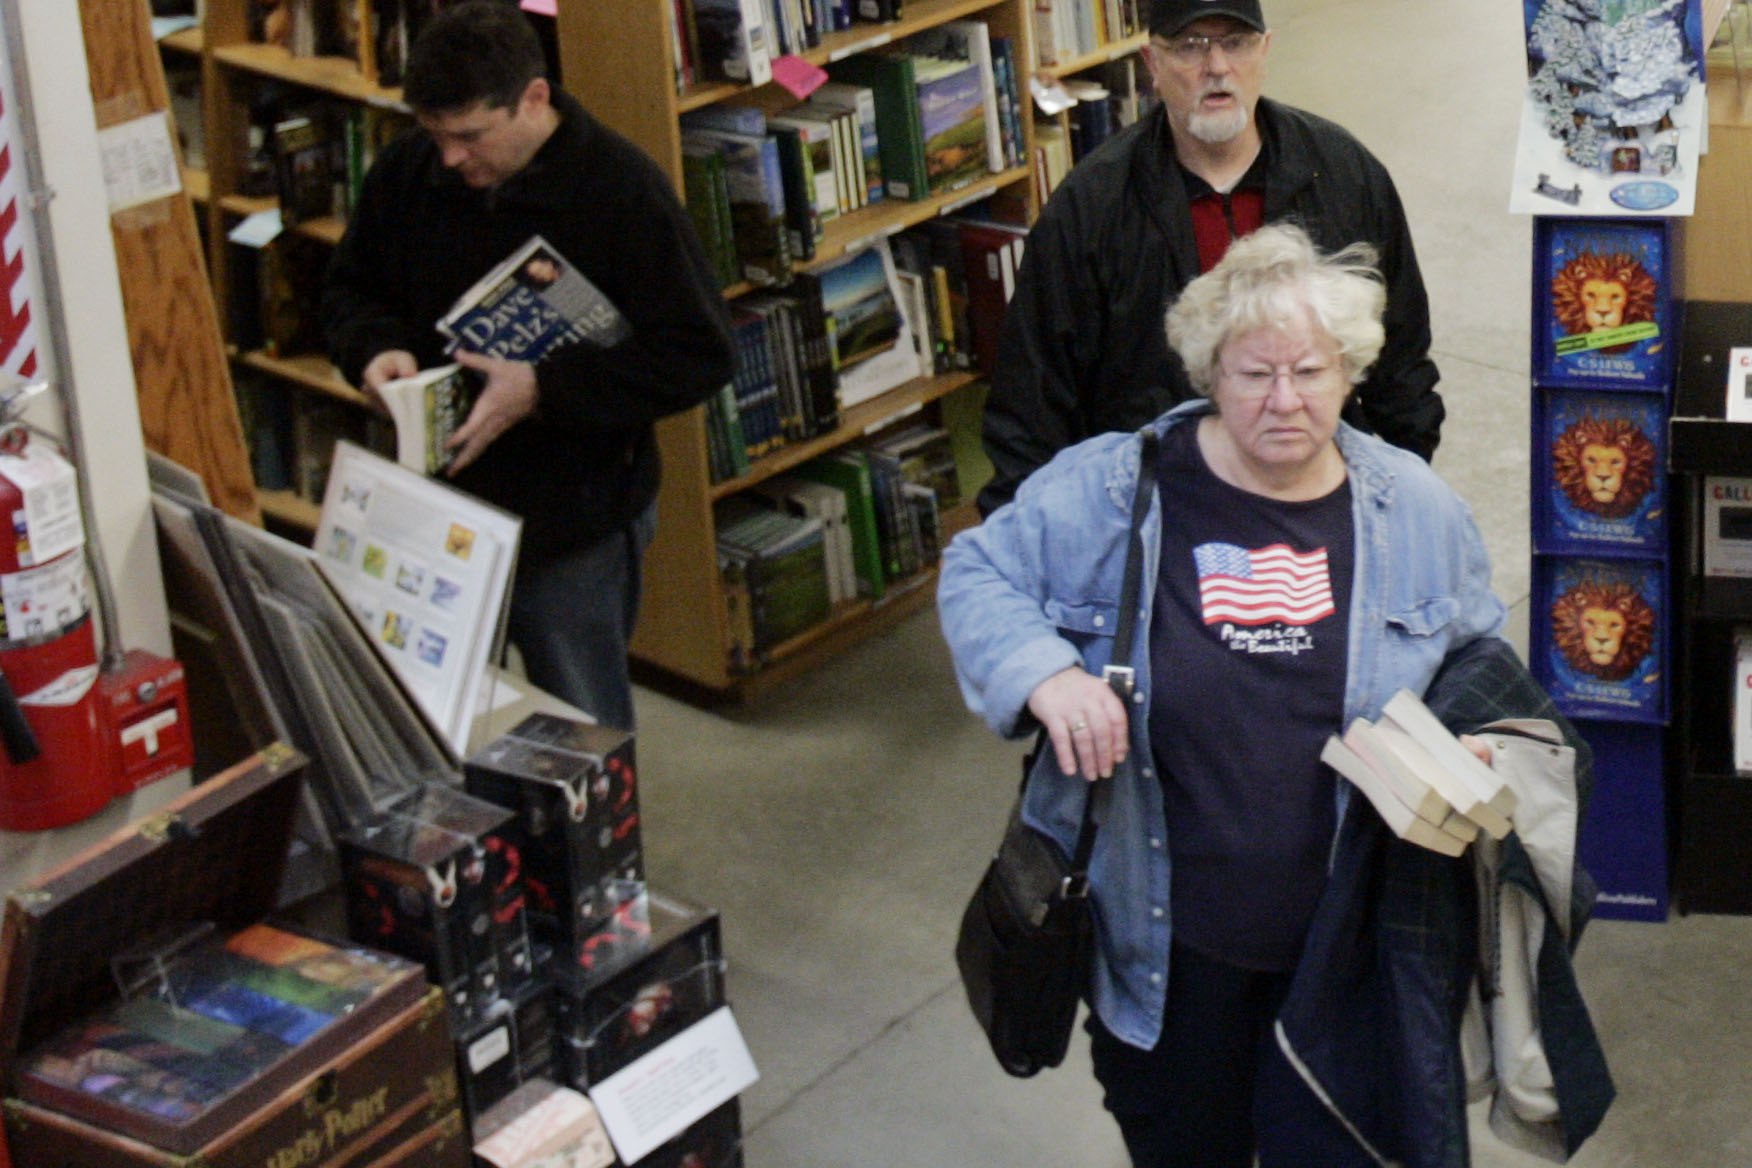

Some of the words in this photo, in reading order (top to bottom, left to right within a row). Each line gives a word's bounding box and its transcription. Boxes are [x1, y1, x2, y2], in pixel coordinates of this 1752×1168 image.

[461, 285, 536, 349] Dave
[1220, 623, 1309, 642] America
[1247, 636, 1315, 656] Beautiful
